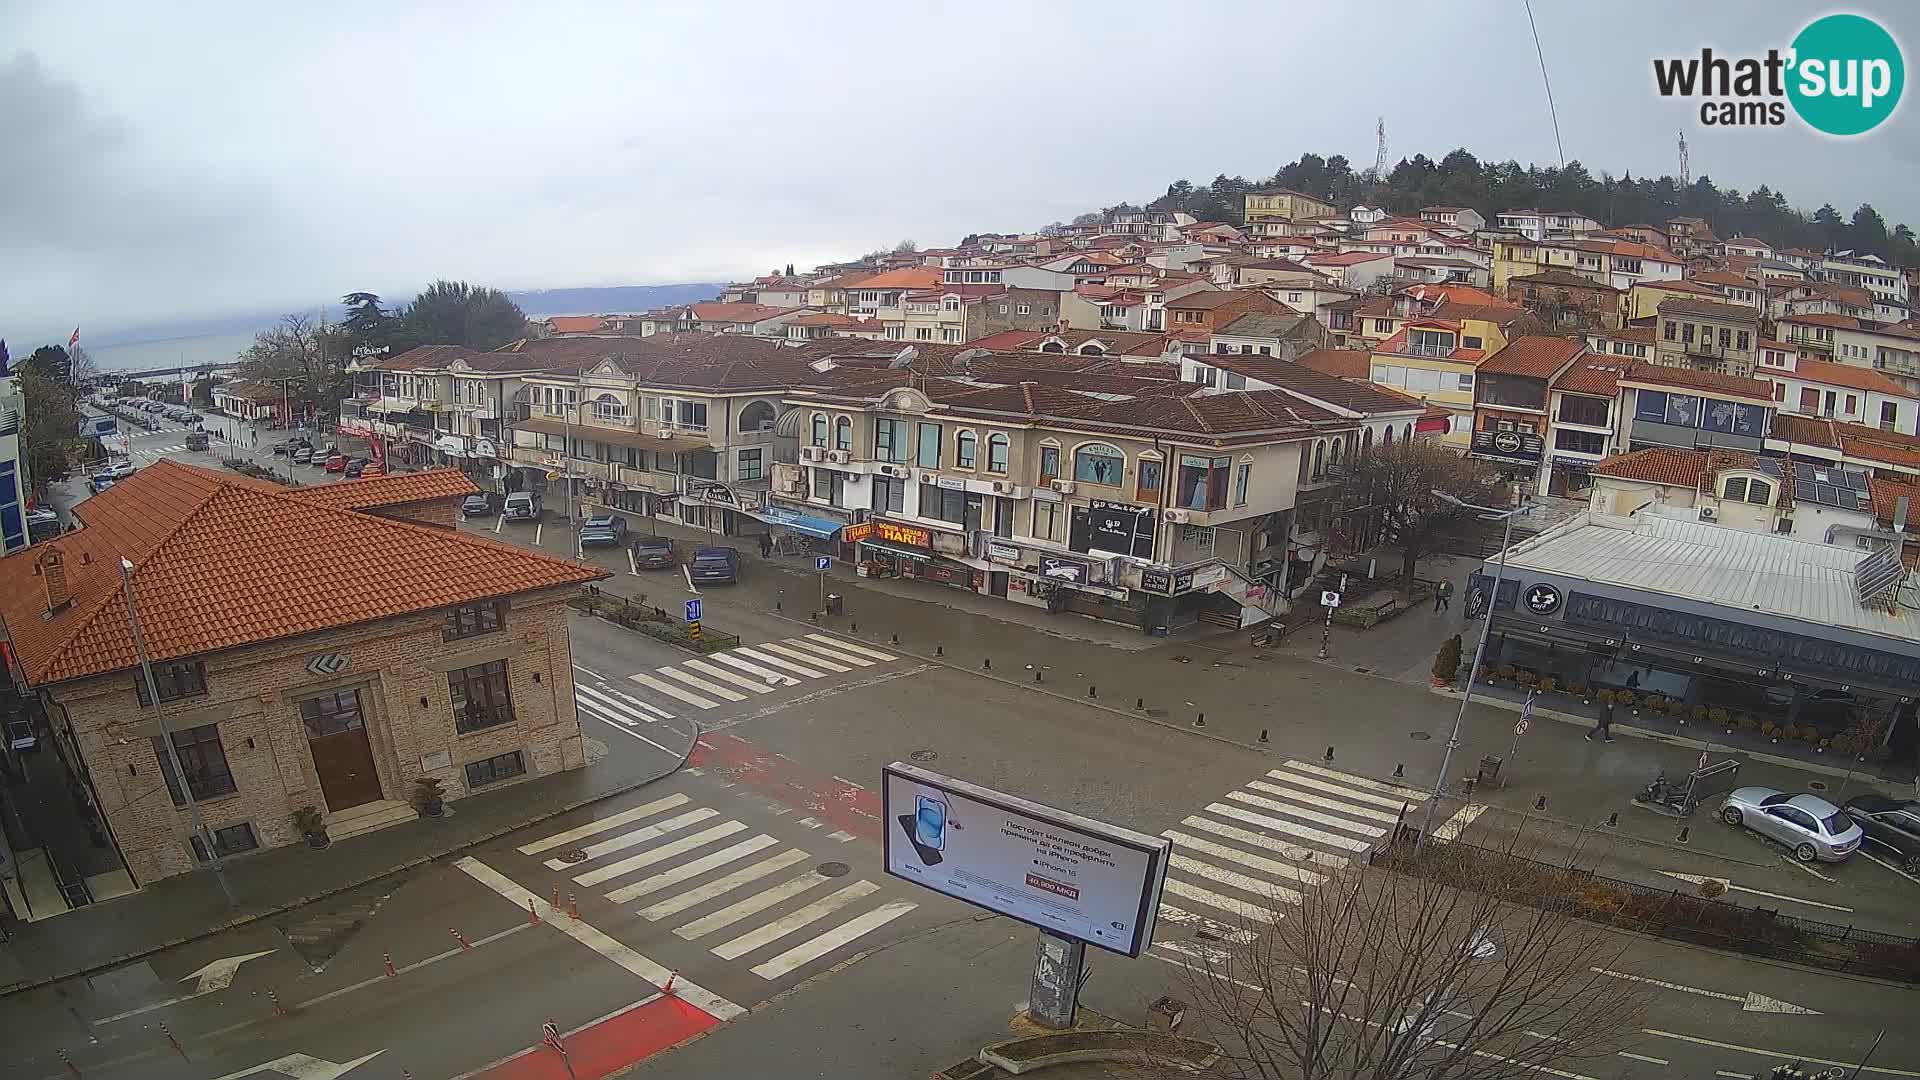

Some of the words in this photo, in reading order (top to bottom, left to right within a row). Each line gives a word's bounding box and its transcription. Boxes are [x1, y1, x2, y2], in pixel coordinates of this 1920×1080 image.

[884, 529, 917, 545] HARI
[819, 558, 828, 568] P
[1000, 828, 1038, 844] причини
[1039, 840, 1051, 849] да
[1052, 844, 1063, 852] се
[1006, 820, 1045, 838] Постојат
[1045, 832, 1081, 849] милион
[1082, 845, 1112, 858] добри
[1036, 847, 1047, 855] на
[1048, 850, 1079, 865] iPhone
[1039, 860, 1067, 874] iPhone
